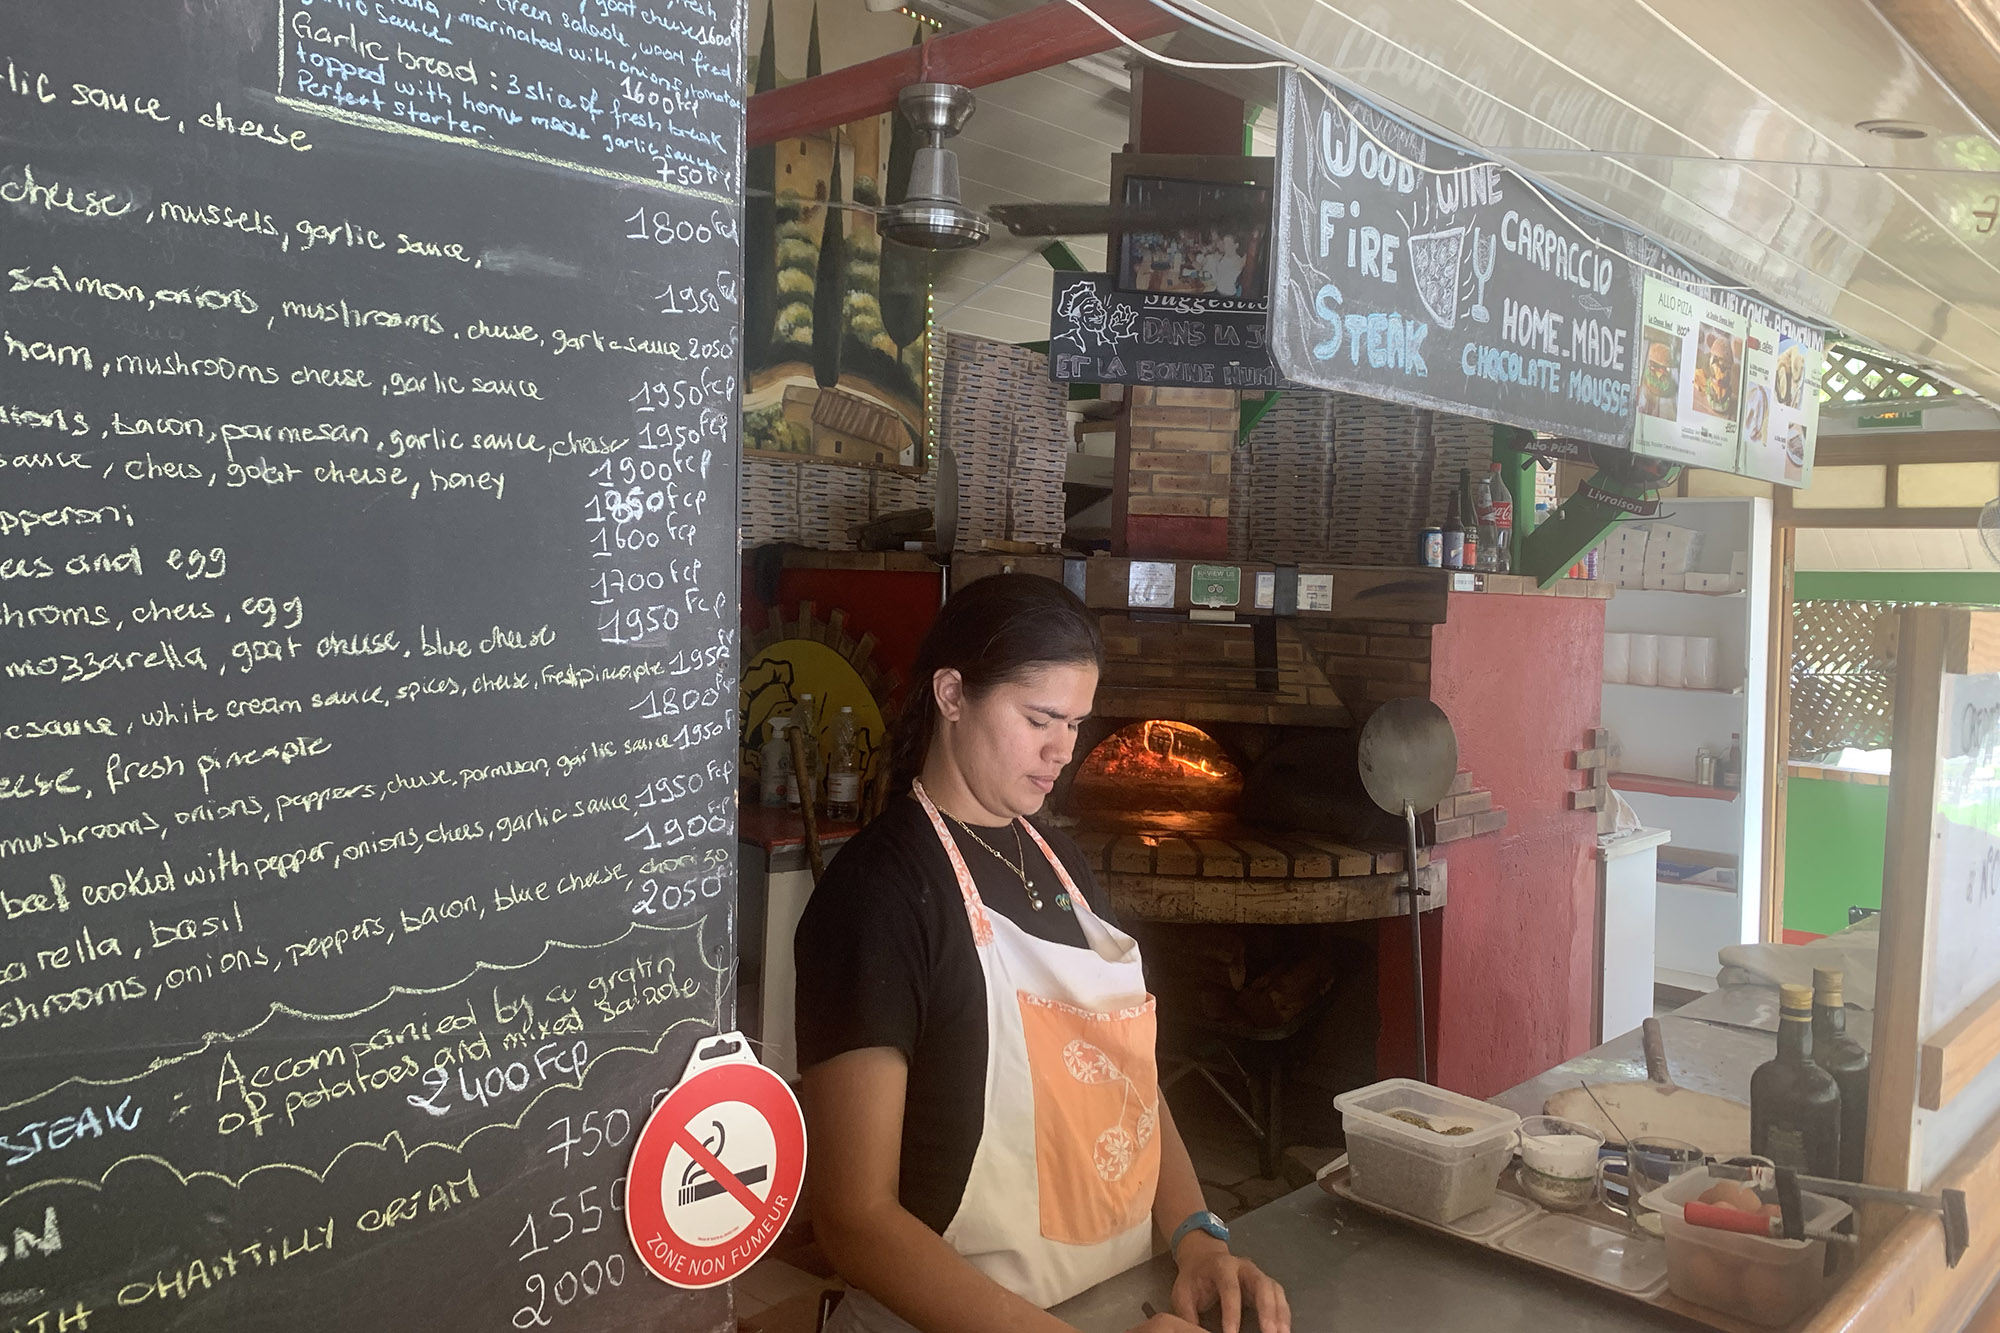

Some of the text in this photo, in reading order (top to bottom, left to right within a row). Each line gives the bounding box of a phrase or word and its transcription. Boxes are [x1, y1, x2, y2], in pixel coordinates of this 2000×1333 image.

[292, 11, 389, 62] Garlic
[506, 75, 521, 95] 3
[0, 56, 56, 103] lic
[394, 80, 452, 106] with
[1322, 110, 1504, 214] WOOD WINE
[295, 219, 386, 252] garlic
[1501, 208, 1613, 296] CARPACCIO
[1657, 293, 1693, 318] ALLO PIZZA
[1143, 316, 1267, 348] DANS LA J
[1313, 284, 1428, 377] STEAK
[391, 370, 466, 396] garlic
[1056, 353, 1091, 379] ET
[1097, 356, 1128, 379] LA
[1135, 360, 1215, 384] BONNE
[1461, 342, 1631, 417] CHOCOLATE MOUSSE
[389, 427, 464, 458] garlic
[1587, 488, 1643, 513] Livraison
[65, 544, 143, 576] and
[165, 547, 227, 582] egg
[0, 602, 121, 631] hroms,
[241, 595, 304, 630] egg
[420, 624, 473, 659] blue
[142, 698, 219, 729] white
[226, 697, 303, 719] cream
[184, 847, 249, 886] with
[494, 881, 550, 912] blue
[0, 900, 243, 984] arella, basil
[493, 986, 535, 1034] by
[219, 1091, 273, 1137] of
[433, 1032, 491, 1071] and
[547, 1107, 630, 1168] 750
[647, 1231, 687, 1273] ZONE
[688, 1255, 726, 1276] NON
[731, 1194, 788, 1265] FUMEUR
[512, 1254, 626, 1329] 2000
